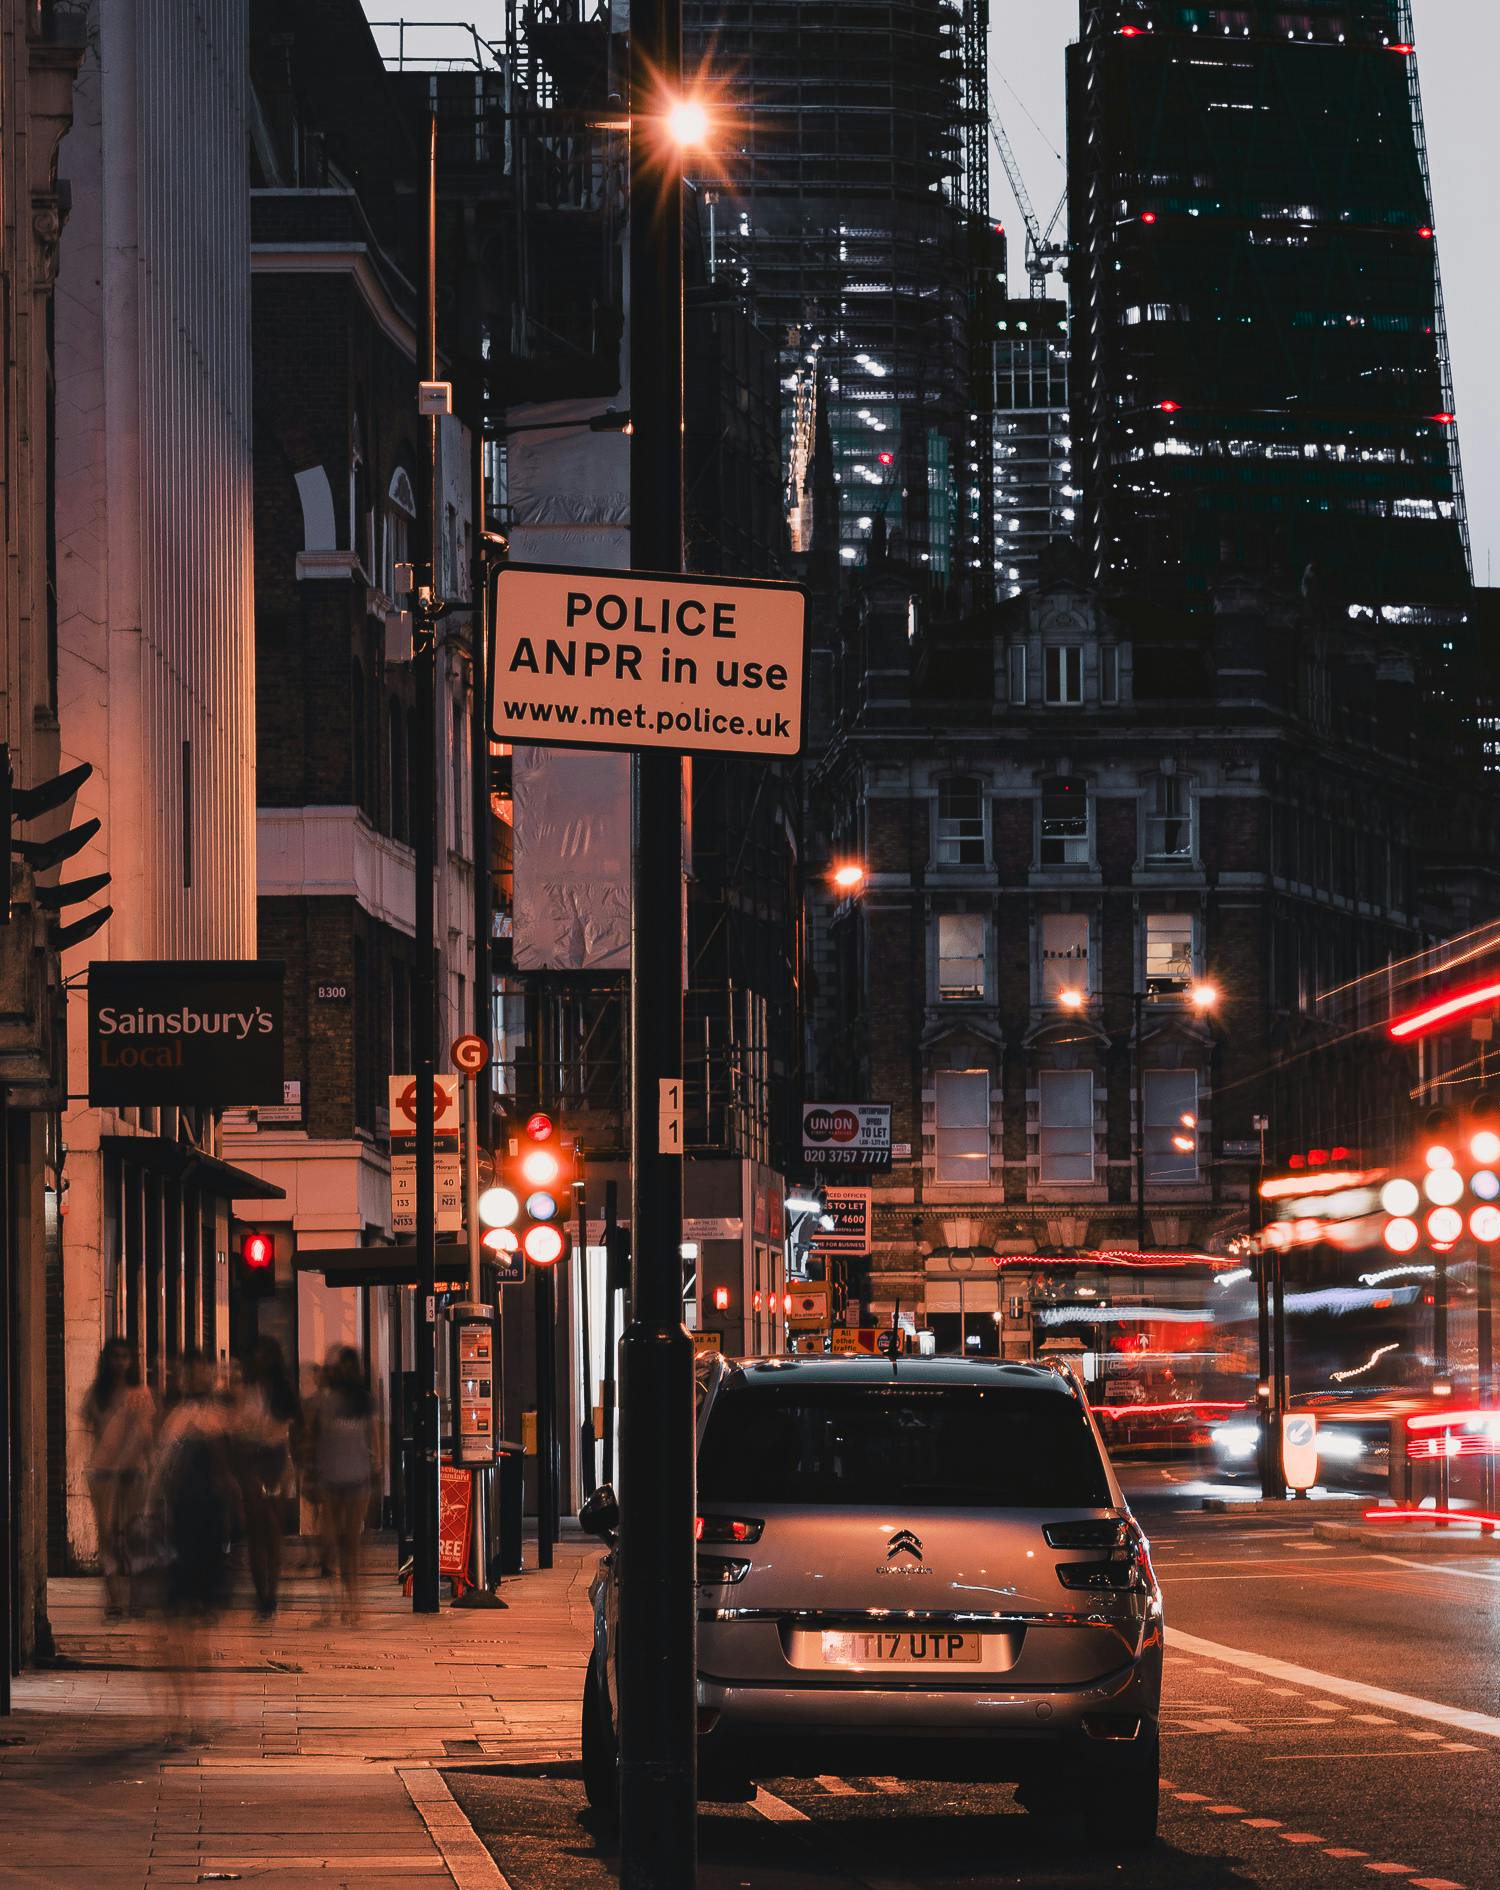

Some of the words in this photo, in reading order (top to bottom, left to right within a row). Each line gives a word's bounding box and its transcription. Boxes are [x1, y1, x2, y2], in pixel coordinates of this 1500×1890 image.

[566, 591, 737, 639] POLICE
[508, 637, 643, 681] ANPR
[661, 647, 697, 684] in
[716, 660, 788, 691] use
[503, 700, 791, 738] www.met.police.uk
[98, 1006, 274, 1040] Sainsbury's
[100, 1039, 184, 1067] Local
[456, 1040, 481, 1067] G
[810, 1118, 853, 1130] UNION
[861, 1127, 872, 1138] TO
[873, 1128, 887, 1138] LET
[804, 1150, 826, 1162] 020
[829, 1150, 857, 1162] 3757
[861, 1151, 889, 1163] 7777
[398, 1180, 408, 1188] 21
[442, 1198, 456, 1206] N21
[393, 1218, 413, 1226] N133
[841, 1216, 865, 1224] 4600
[440, 1540, 463, 1556] REE
[909, 1634, 965, 1659] UTP
